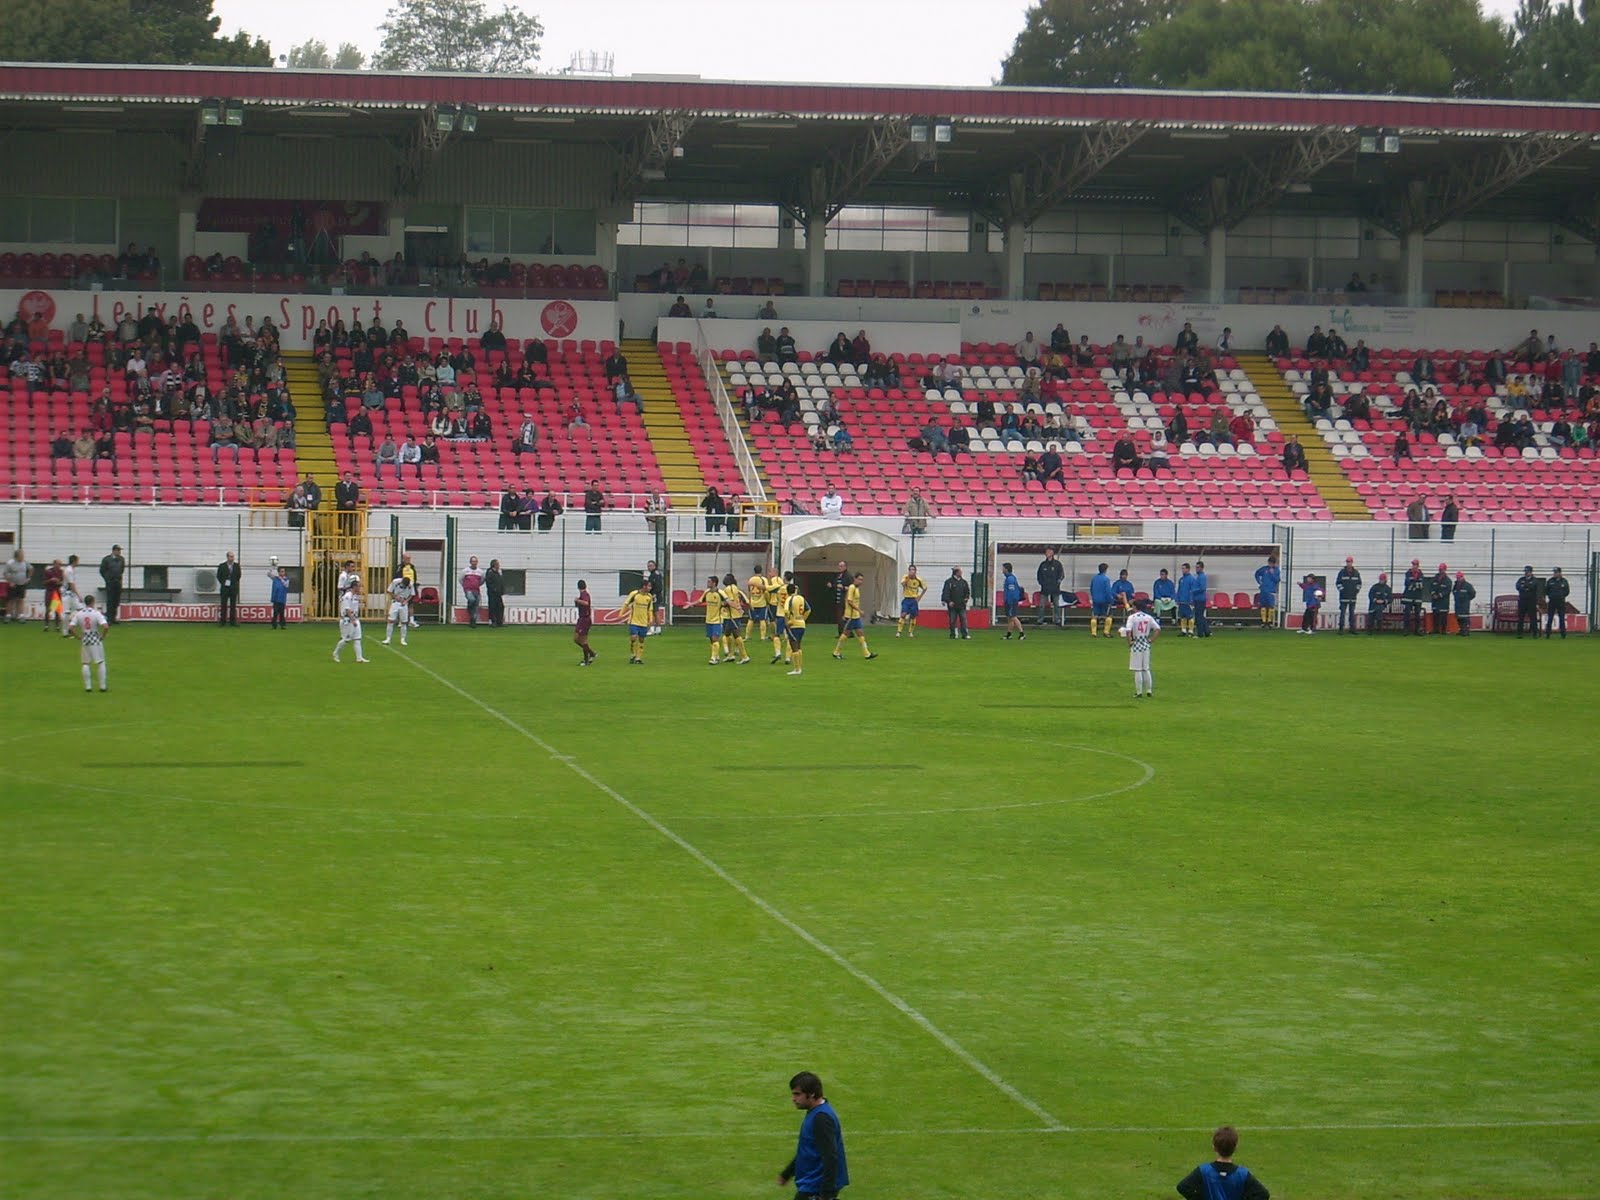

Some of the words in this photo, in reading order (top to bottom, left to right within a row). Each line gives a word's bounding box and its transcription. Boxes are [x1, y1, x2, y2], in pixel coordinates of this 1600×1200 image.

[280, 297, 381, 340] Sport
[424, 298, 504, 333] Club
[503, 607, 578, 623] ATOSINHO
[1137, 621, 1148, 634] 47
